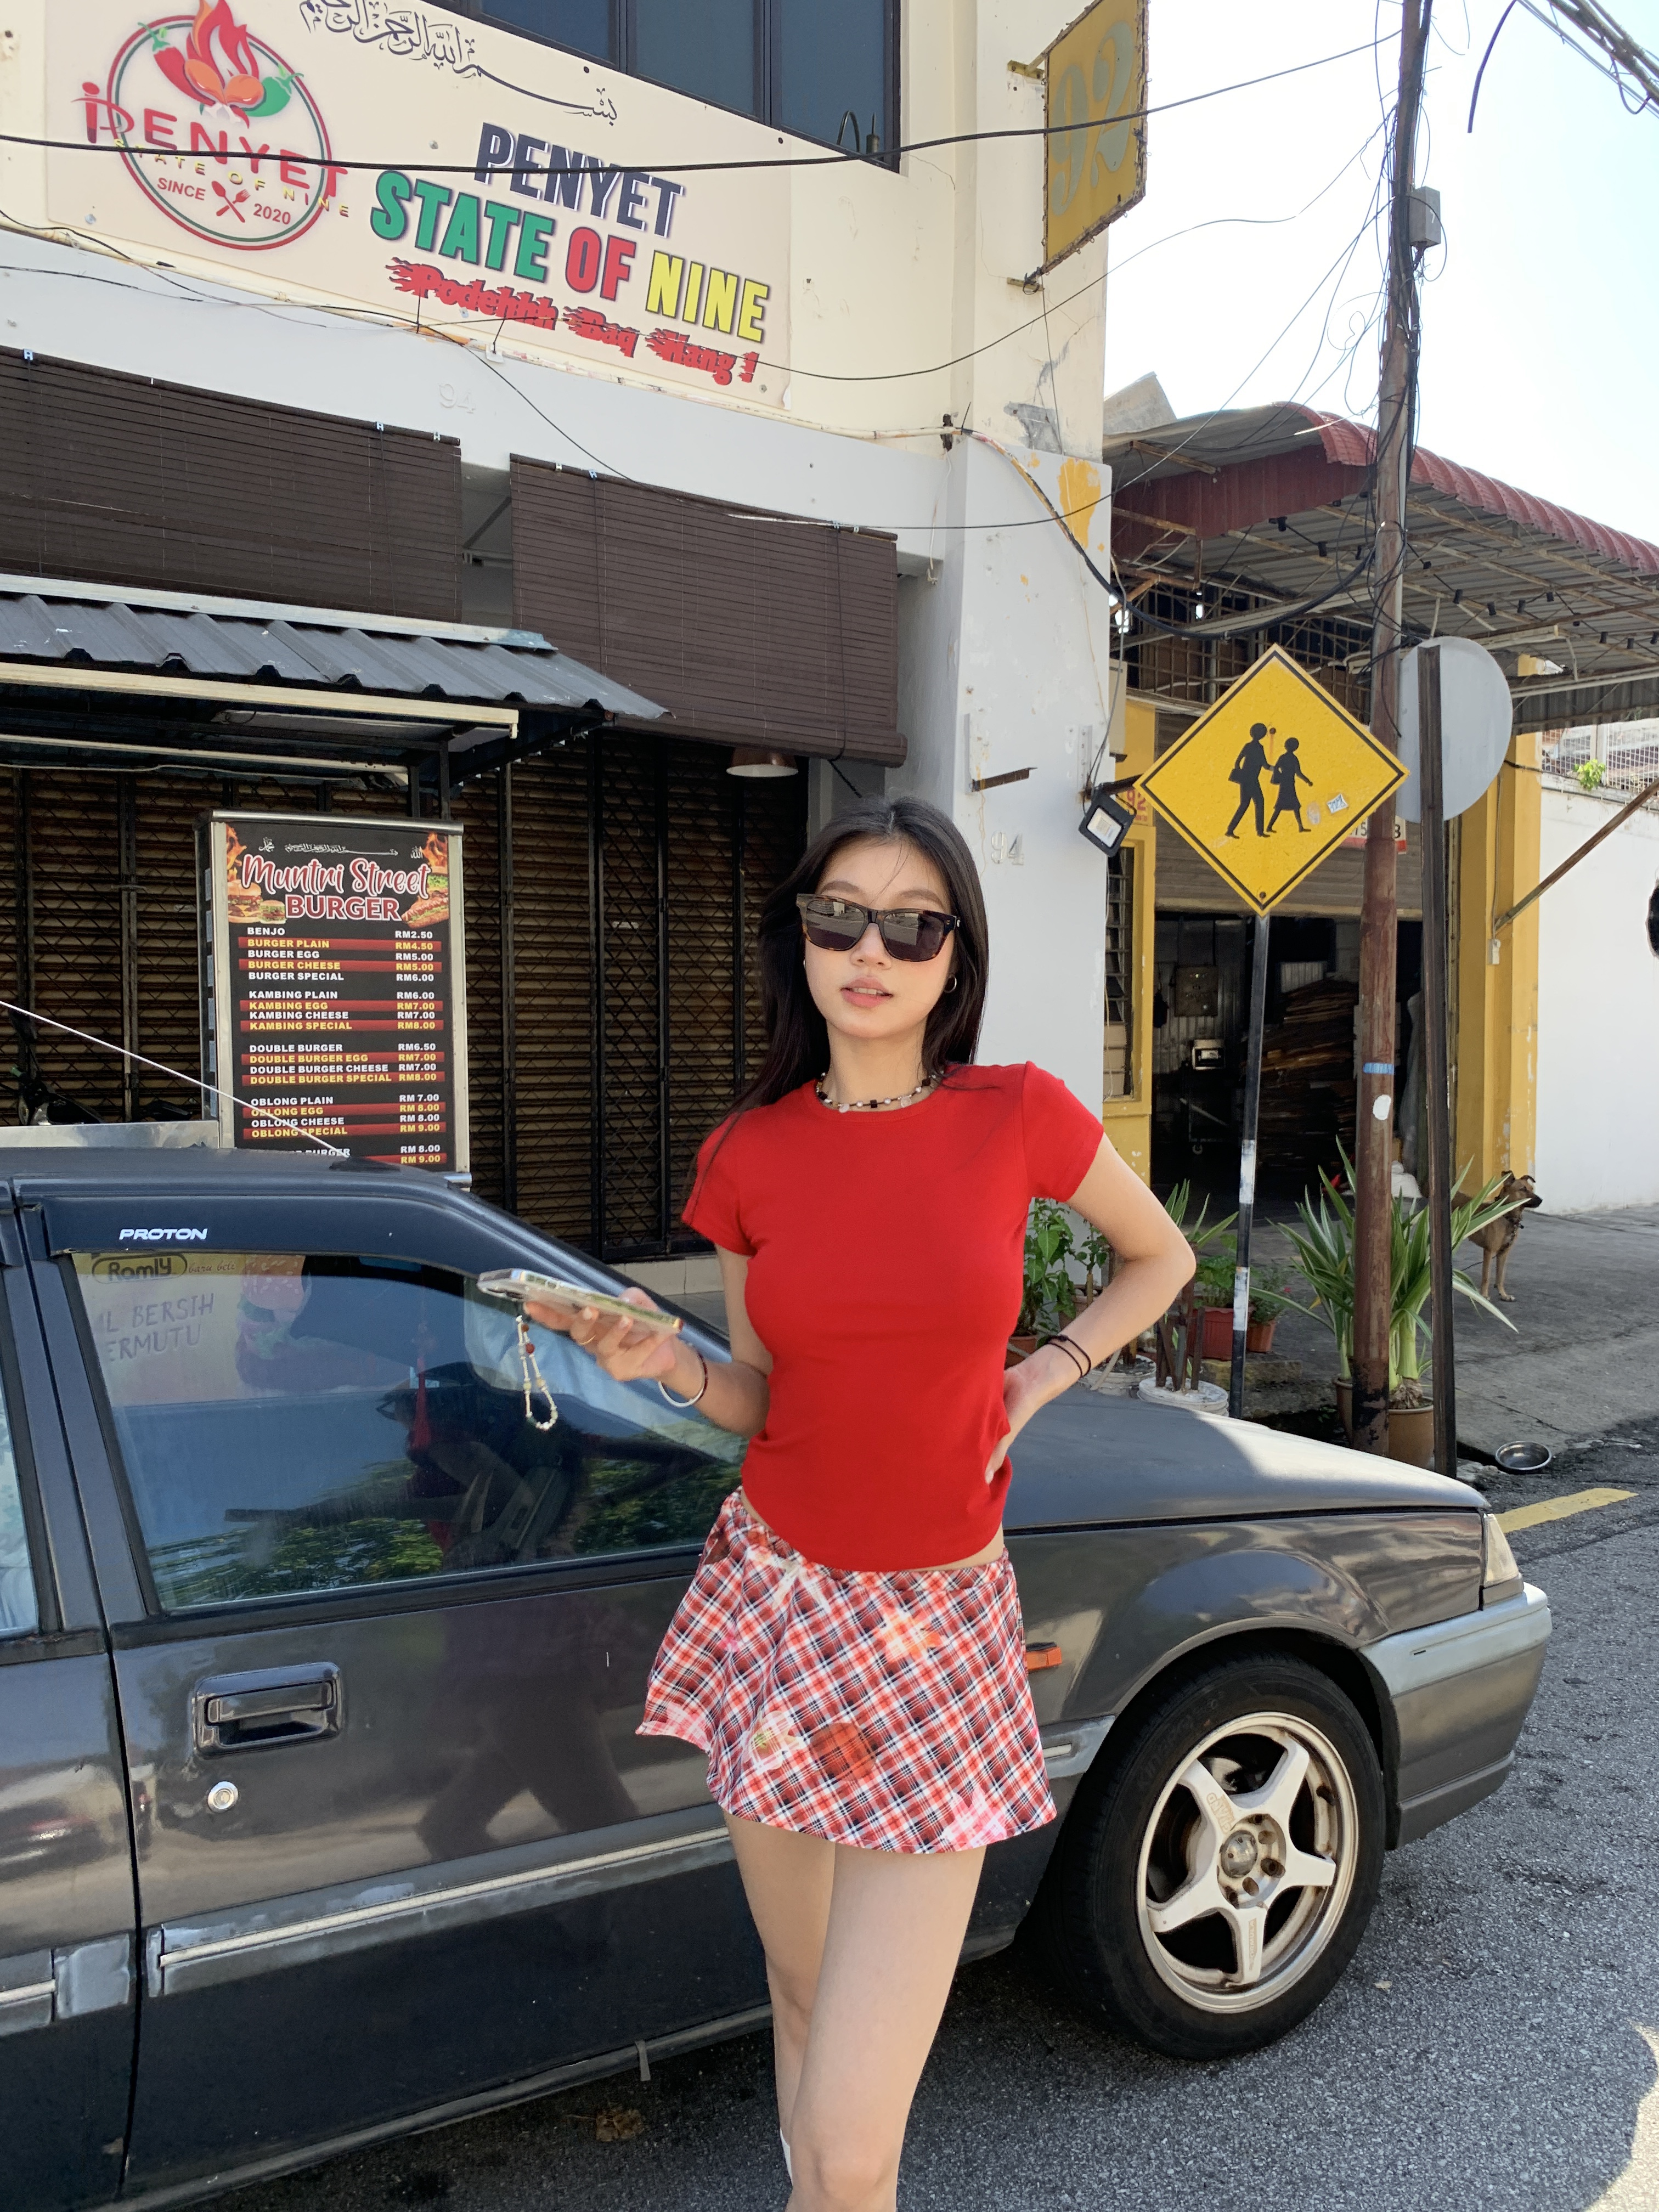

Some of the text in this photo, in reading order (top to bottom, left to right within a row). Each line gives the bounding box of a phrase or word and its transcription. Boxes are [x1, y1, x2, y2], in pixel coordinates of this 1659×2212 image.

[1051, 21, 1133, 216] 92
[474, 122, 685, 239] PENYET
[157, 177, 206, 201] SINCE
[228, 171, 266, 191] OF
[283, 188, 349, 217] NINE
[253, 204, 291, 225] 2020
[370, 169, 771, 343] STATE OF NINE
[242, 854, 431, 899] Muntri Street
[285, 894, 402, 922] BURGER
[247, 927, 433, 939] BENJO RM2.50
[249, 991, 302, 999] KAMBING
[250, 1045, 295, 1053] DOUBLE
[298, 1044, 343, 1052] BURGER
[298, 1054, 343, 1063] BURGER
[399, 1063, 436, 1071] RM7.00
[250, 1076, 296, 1084] DOUBLE
[298, 1075, 343, 1084] BURGER
[346, 1074, 392, 1082] SPECIAL
[251, 1098, 297, 1107] OBLONG
[300, 1097, 334, 1105] PLAIN
[251, 1108, 298, 1116] OBLONG
[251, 1119, 298, 1127] OBLONG
[252, 1129, 298, 1137] OBLONG
[301, 1127, 347, 1136] SPECIAL
[419, 1144, 440, 1153] 8.00
[419, 1155, 441, 1163] 9.00
[119, 1228, 208, 1240] PROTON
[132, 1293, 214, 1328] BERSIH
